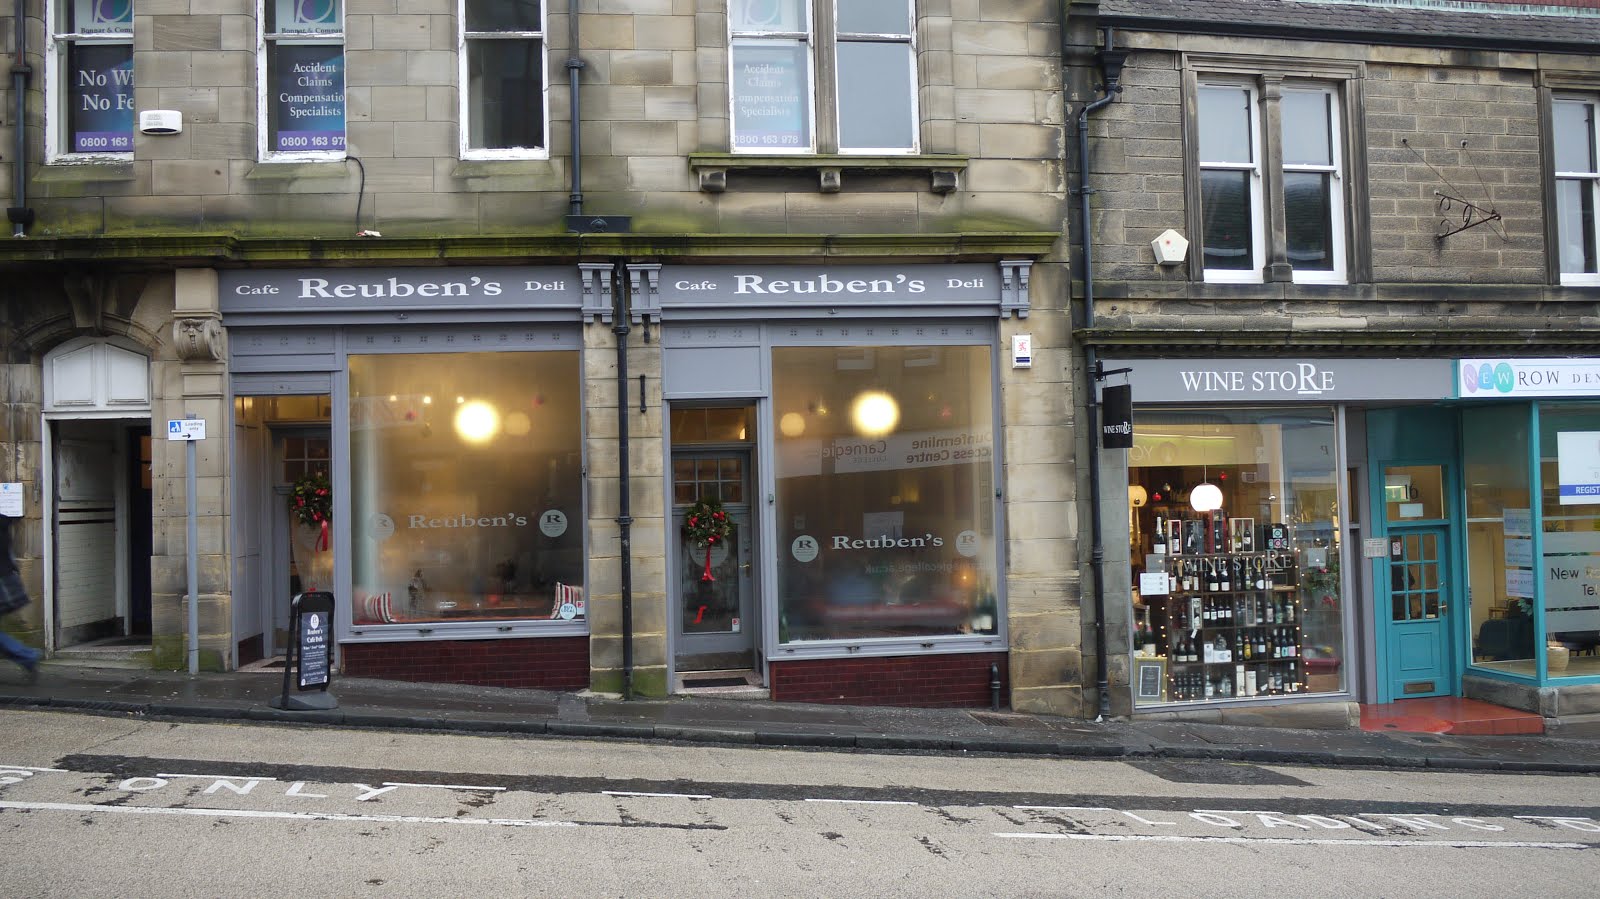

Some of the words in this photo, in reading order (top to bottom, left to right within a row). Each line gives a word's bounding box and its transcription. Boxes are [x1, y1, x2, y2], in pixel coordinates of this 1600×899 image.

[293, 62, 336, 73] Accident
[743, 64, 784, 74] Accident
[80, 70, 107, 86] No
[297, 76, 333, 87] Claims
[747, 77, 781, 87] Claims
[82, 94, 111, 111] No
[116, 93, 134, 110] Fe
[290, 106, 341, 118] Specialists
[741, 106, 791, 116] Specialists
[80, 137, 107, 147] 0800
[111, 137, 128, 146] 163
[281, 137, 308, 146] 0800
[311, 137, 328, 146] 163
[735, 135, 758, 144] 0800
[761, 135, 778, 144] 163
[781, 135, 798, 144] 978
[235, 283, 280, 296] Cafe
[298, 276, 503, 299] Reuben's
[524, 280, 566, 291] Deli
[675, 280, 718, 291] Cafe
[733, 273, 926, 295] Reuben's
[946, 277, 984, 289] Deli
[1180, 371, 1245, 391] WINE
[1466, 371, 1511, 386] NEW
[1518, 370, 1560, 386] ROW
[1404, 483, 1418, 500] 16
[408, 512, 528, 529] Reuben's
[831, 533, 944, 550] Reuben's
[1183, 556, 1227, 571] WINE
[1551, 568, 1579, 580] New
[119, 777, 399, 800] ONLY
[1121, 811, 1505, 831] LOADING
